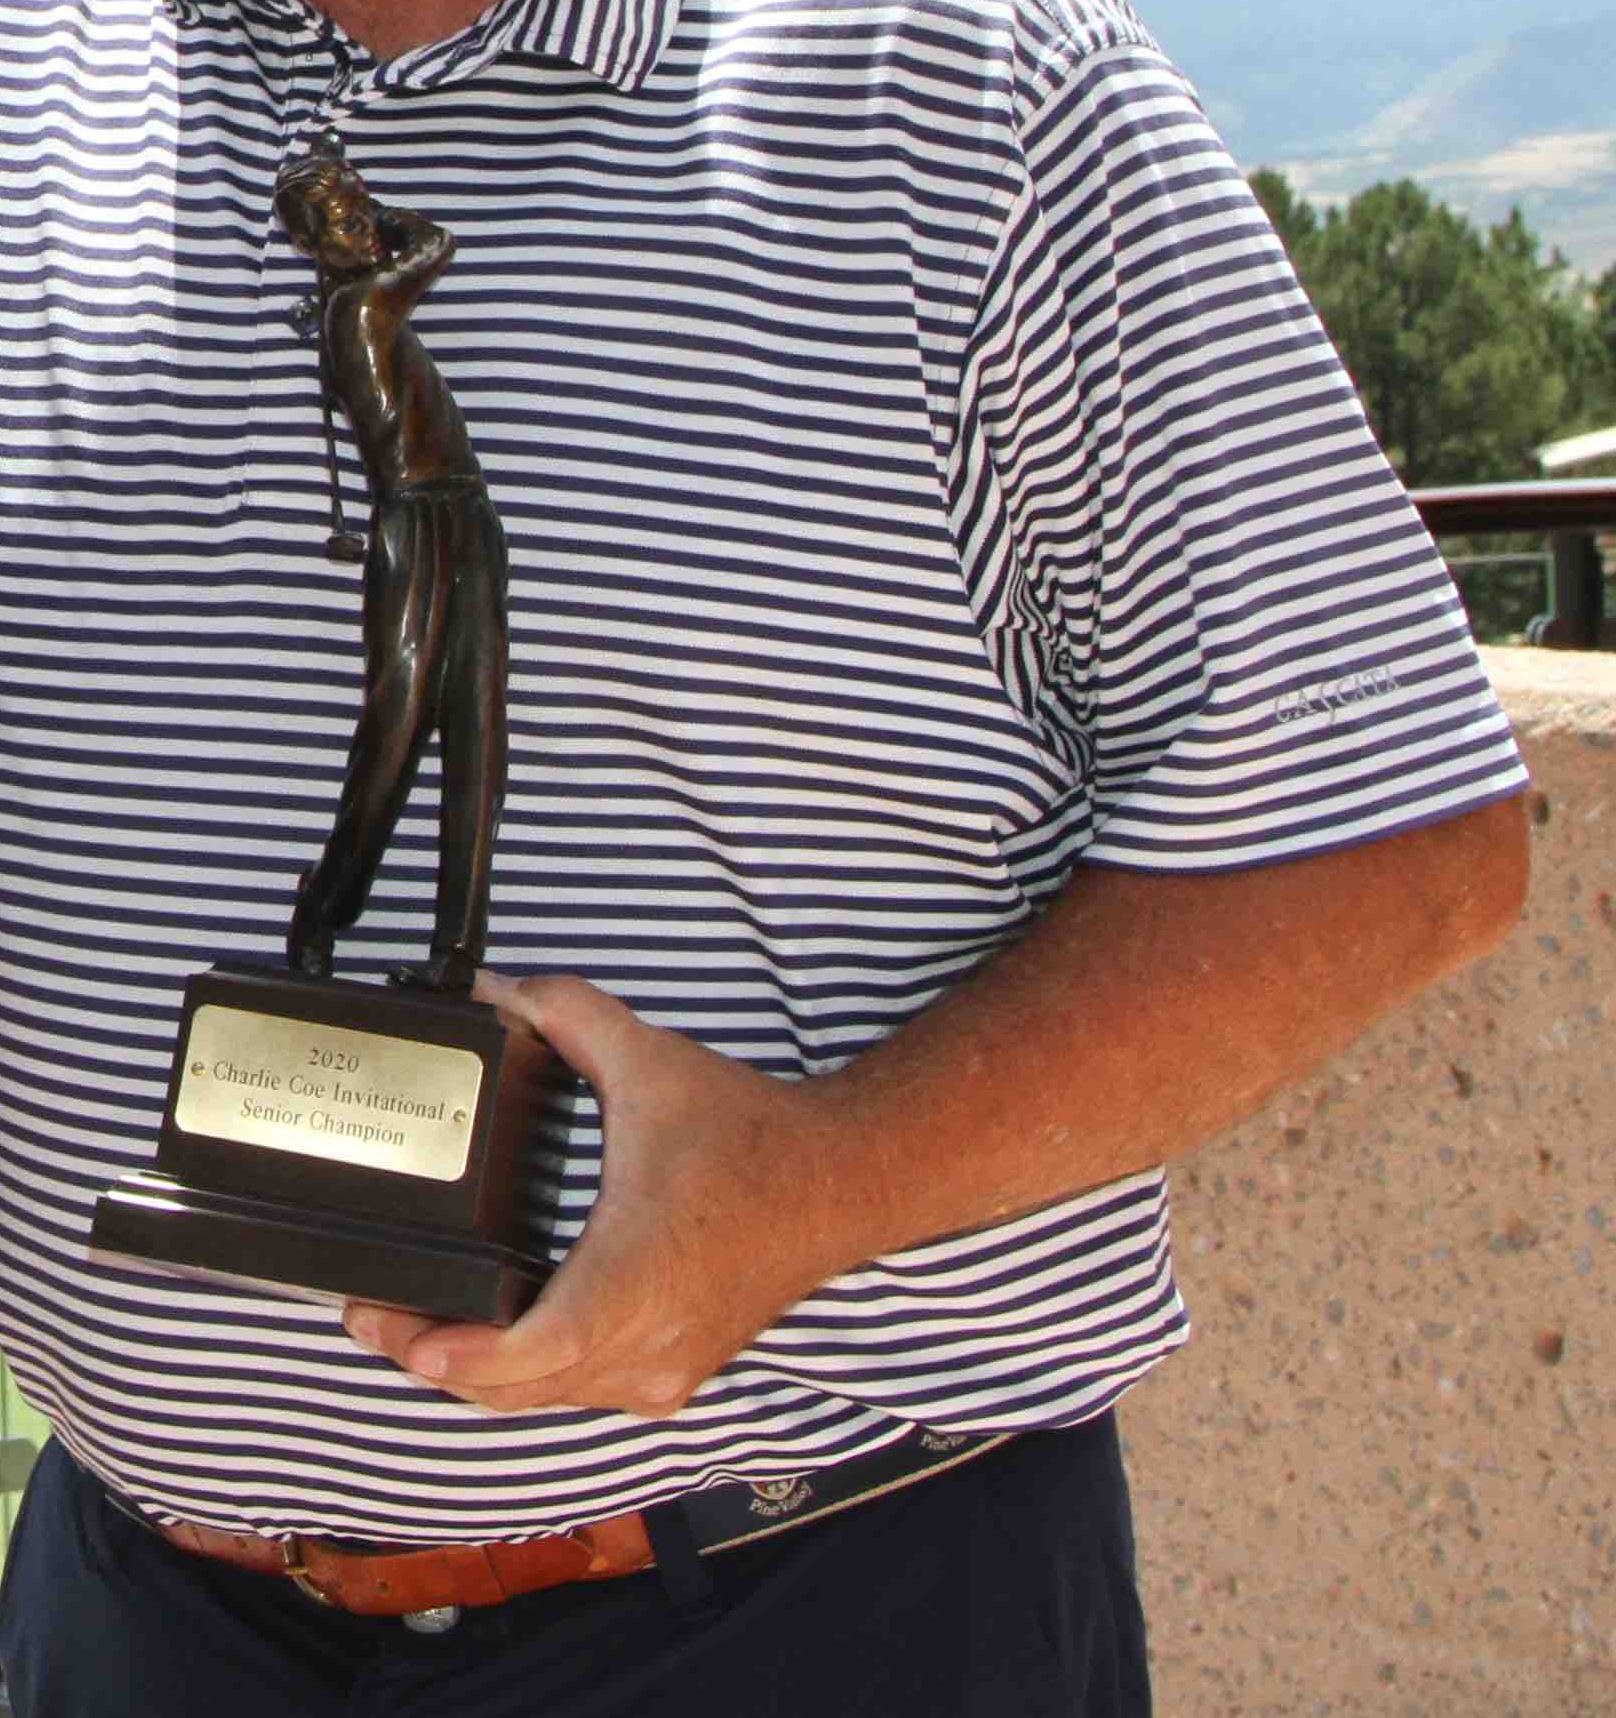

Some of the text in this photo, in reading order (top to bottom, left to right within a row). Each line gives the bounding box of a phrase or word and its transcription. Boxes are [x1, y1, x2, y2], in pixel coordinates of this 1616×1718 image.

[307, 1047, 360, 1074] 2020
[213, 1059, 446, 1121] Charlie Coe Invitational
[240, 1097, 406, 1147] Senior Champion
